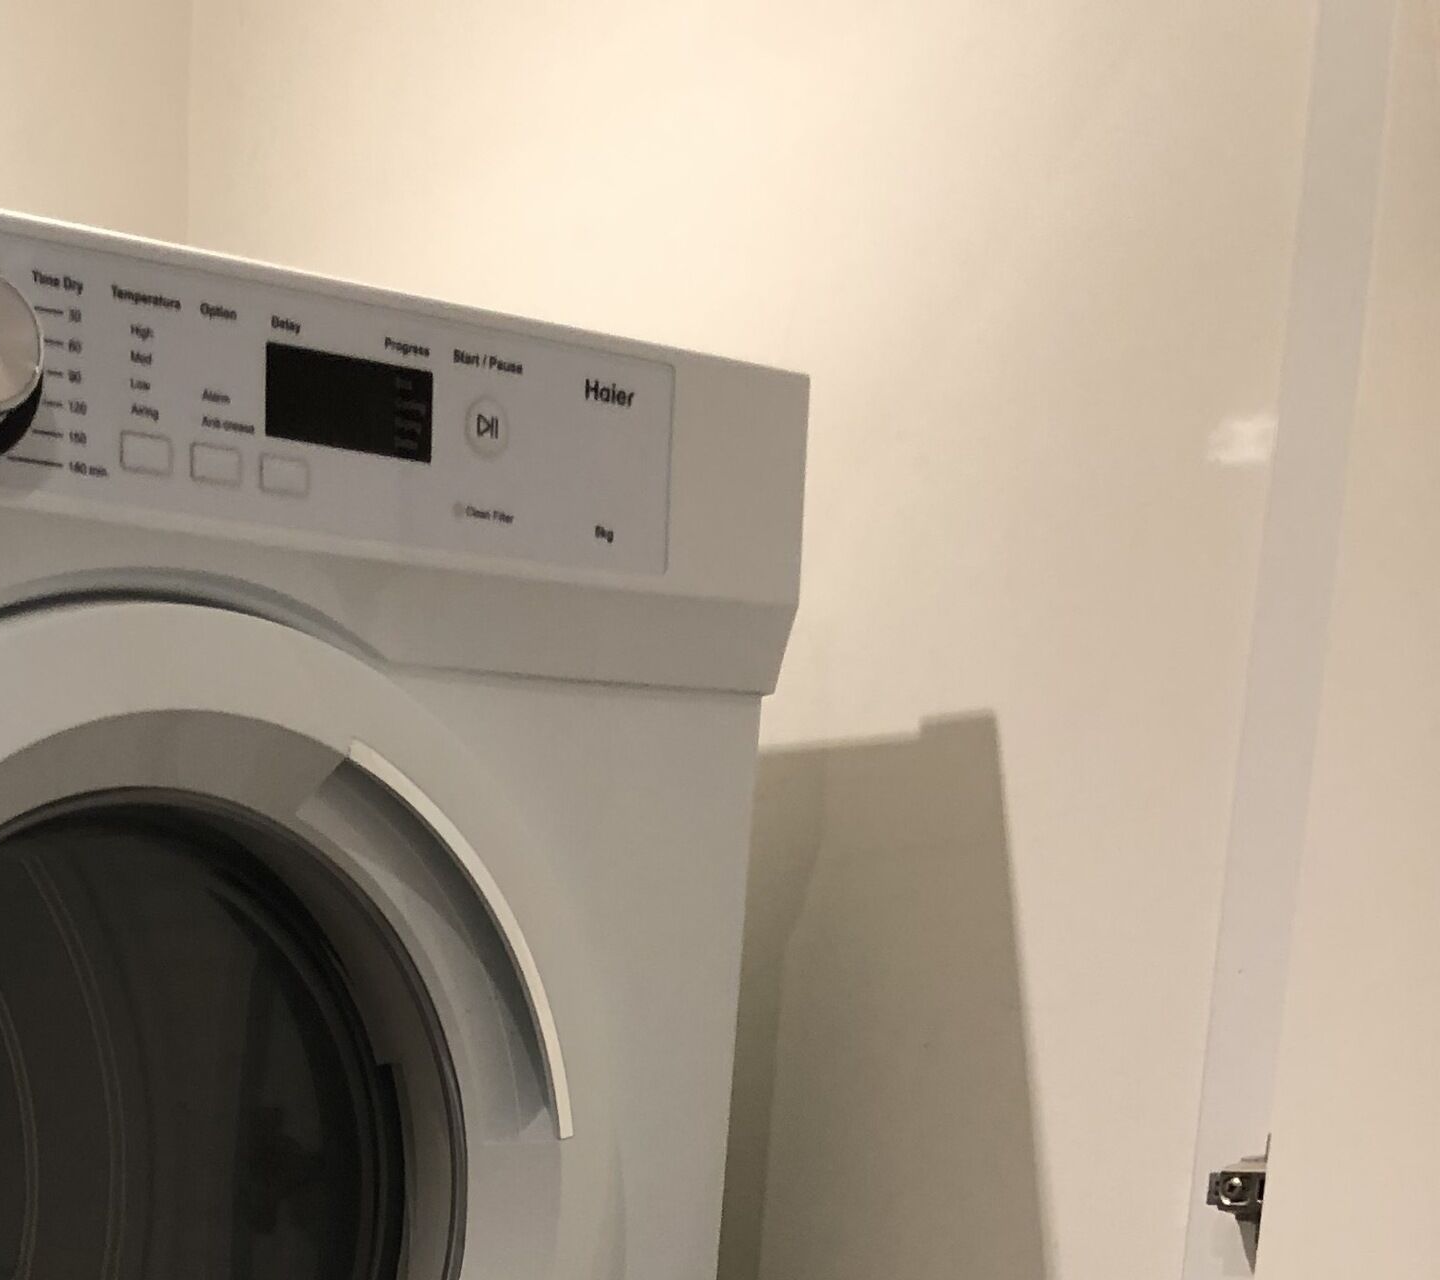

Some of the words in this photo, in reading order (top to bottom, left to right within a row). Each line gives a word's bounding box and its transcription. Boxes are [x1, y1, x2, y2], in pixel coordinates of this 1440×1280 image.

[32, 270, 59, 286] Time
[64, 276, 84, 295] Dry
[112, 284, 181, 309] Temperature
[200, 302, 237, 320] Option
[130, 324, 153, 340] High
[271, 314, 301, 335] Delay
[384, 336, 431, 357] Progress
[130, 351, 152, 365] Med
[453, 348, 479, 368] Start
[489, 355, 523, 374] Pause
[130, 378, 150, 390] Low
[585, 378, 635, 408] Haier
